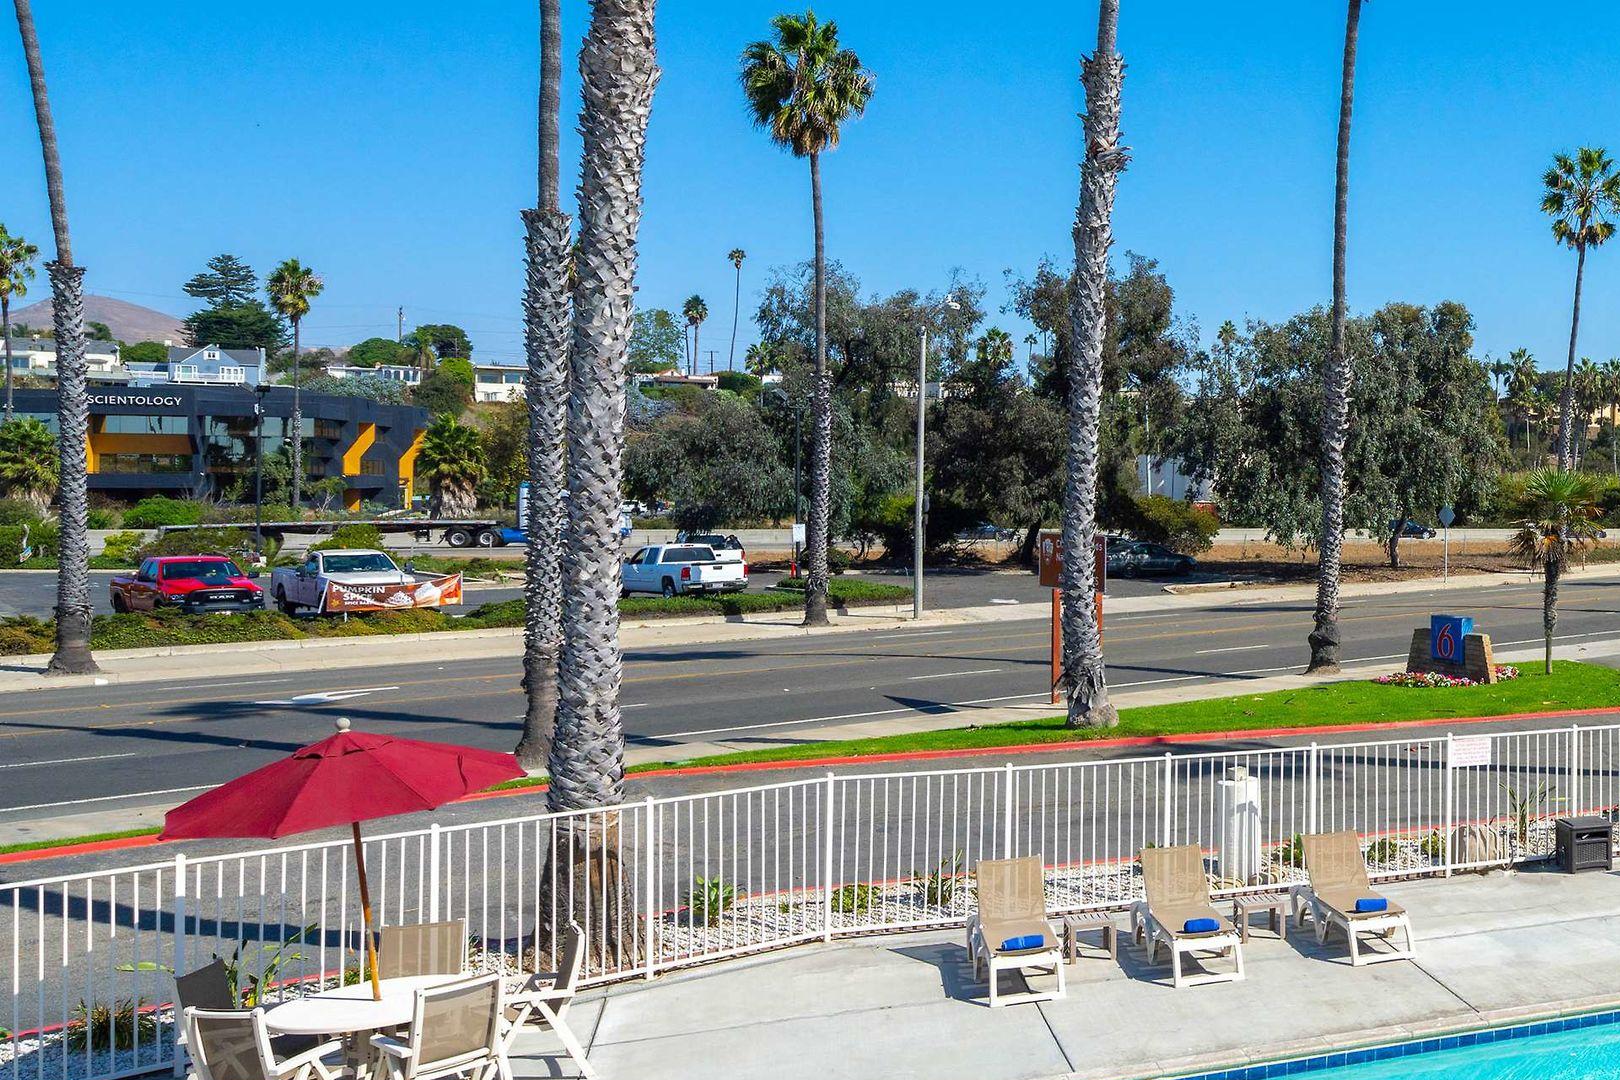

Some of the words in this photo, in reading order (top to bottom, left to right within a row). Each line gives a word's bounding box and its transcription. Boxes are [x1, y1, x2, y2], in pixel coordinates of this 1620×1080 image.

[87, 395, 182, 406] SCIENTOLOGY
[332, 584, 386, 594] PUMPKIN
[1436, 623, 1454, 659] 6
